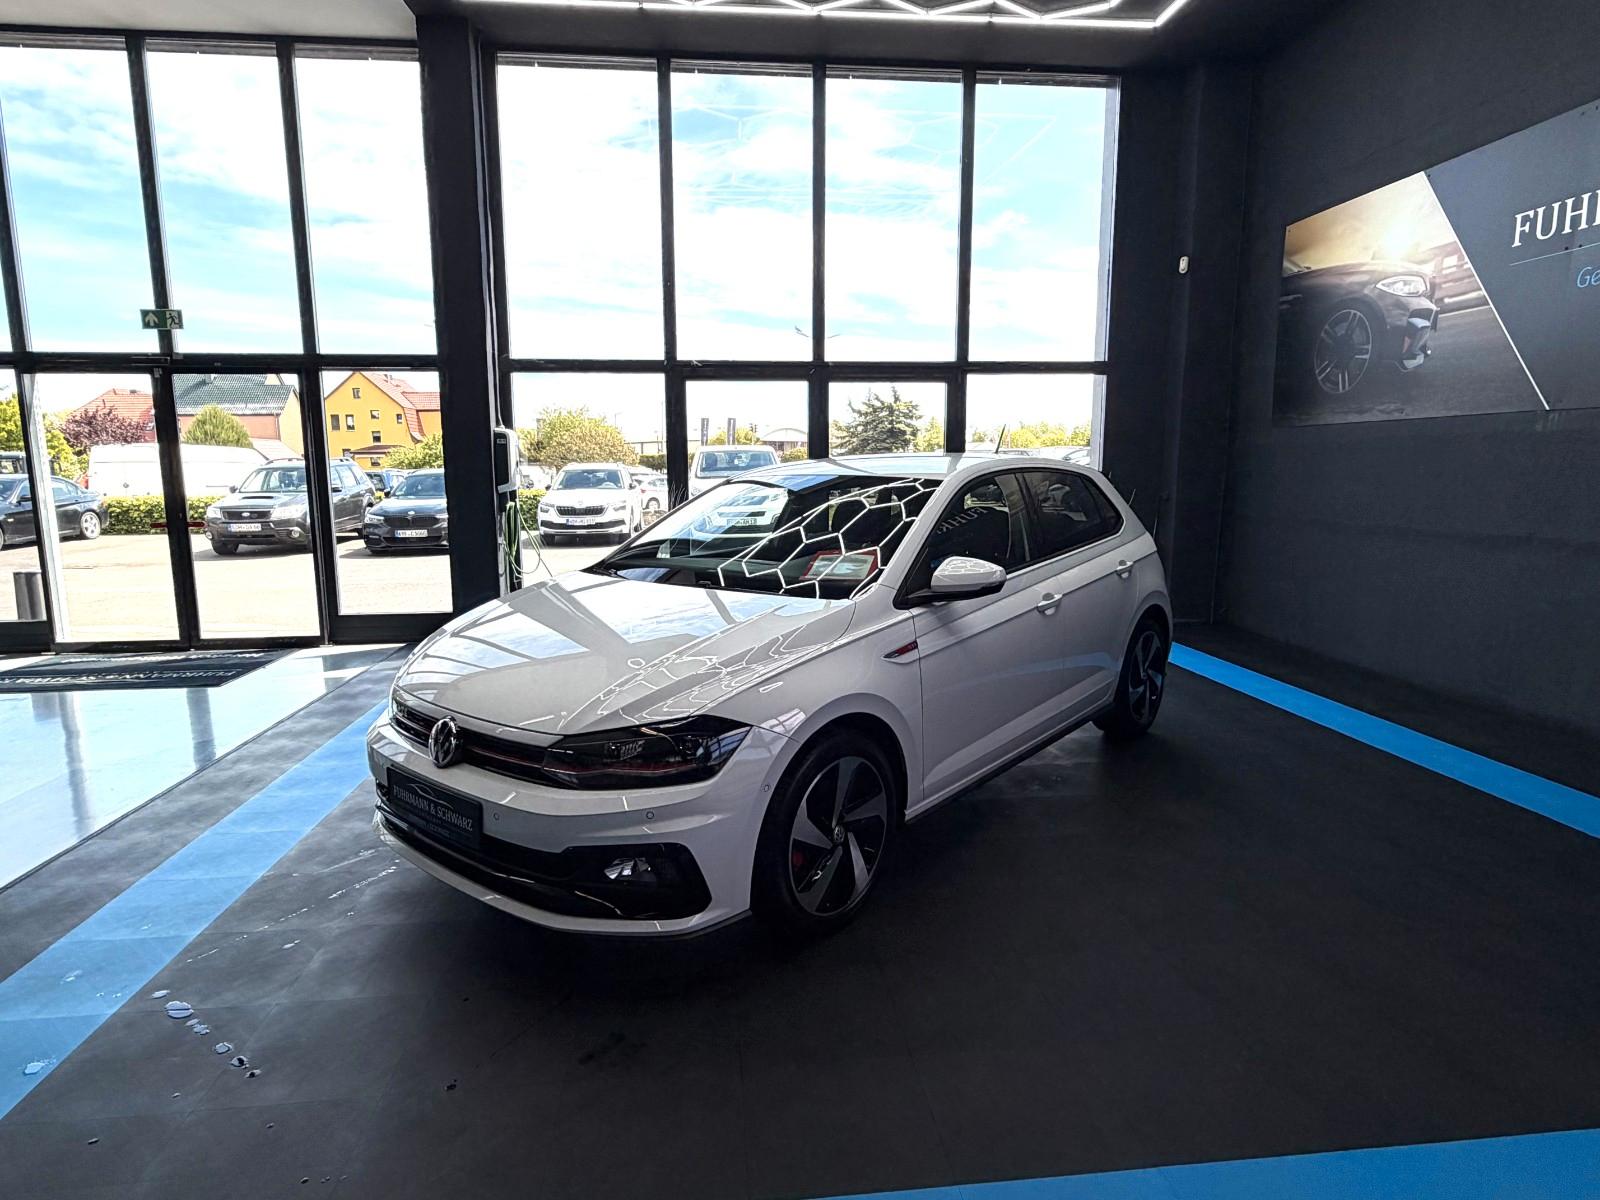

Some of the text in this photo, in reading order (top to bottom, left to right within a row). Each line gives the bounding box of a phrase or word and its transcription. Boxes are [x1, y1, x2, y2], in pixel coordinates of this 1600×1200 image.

[393, 785, 429, 811] FUHRMANN
[430, 805, 437, 816] &
[438, 806, 473, 832] SCHWARZ
